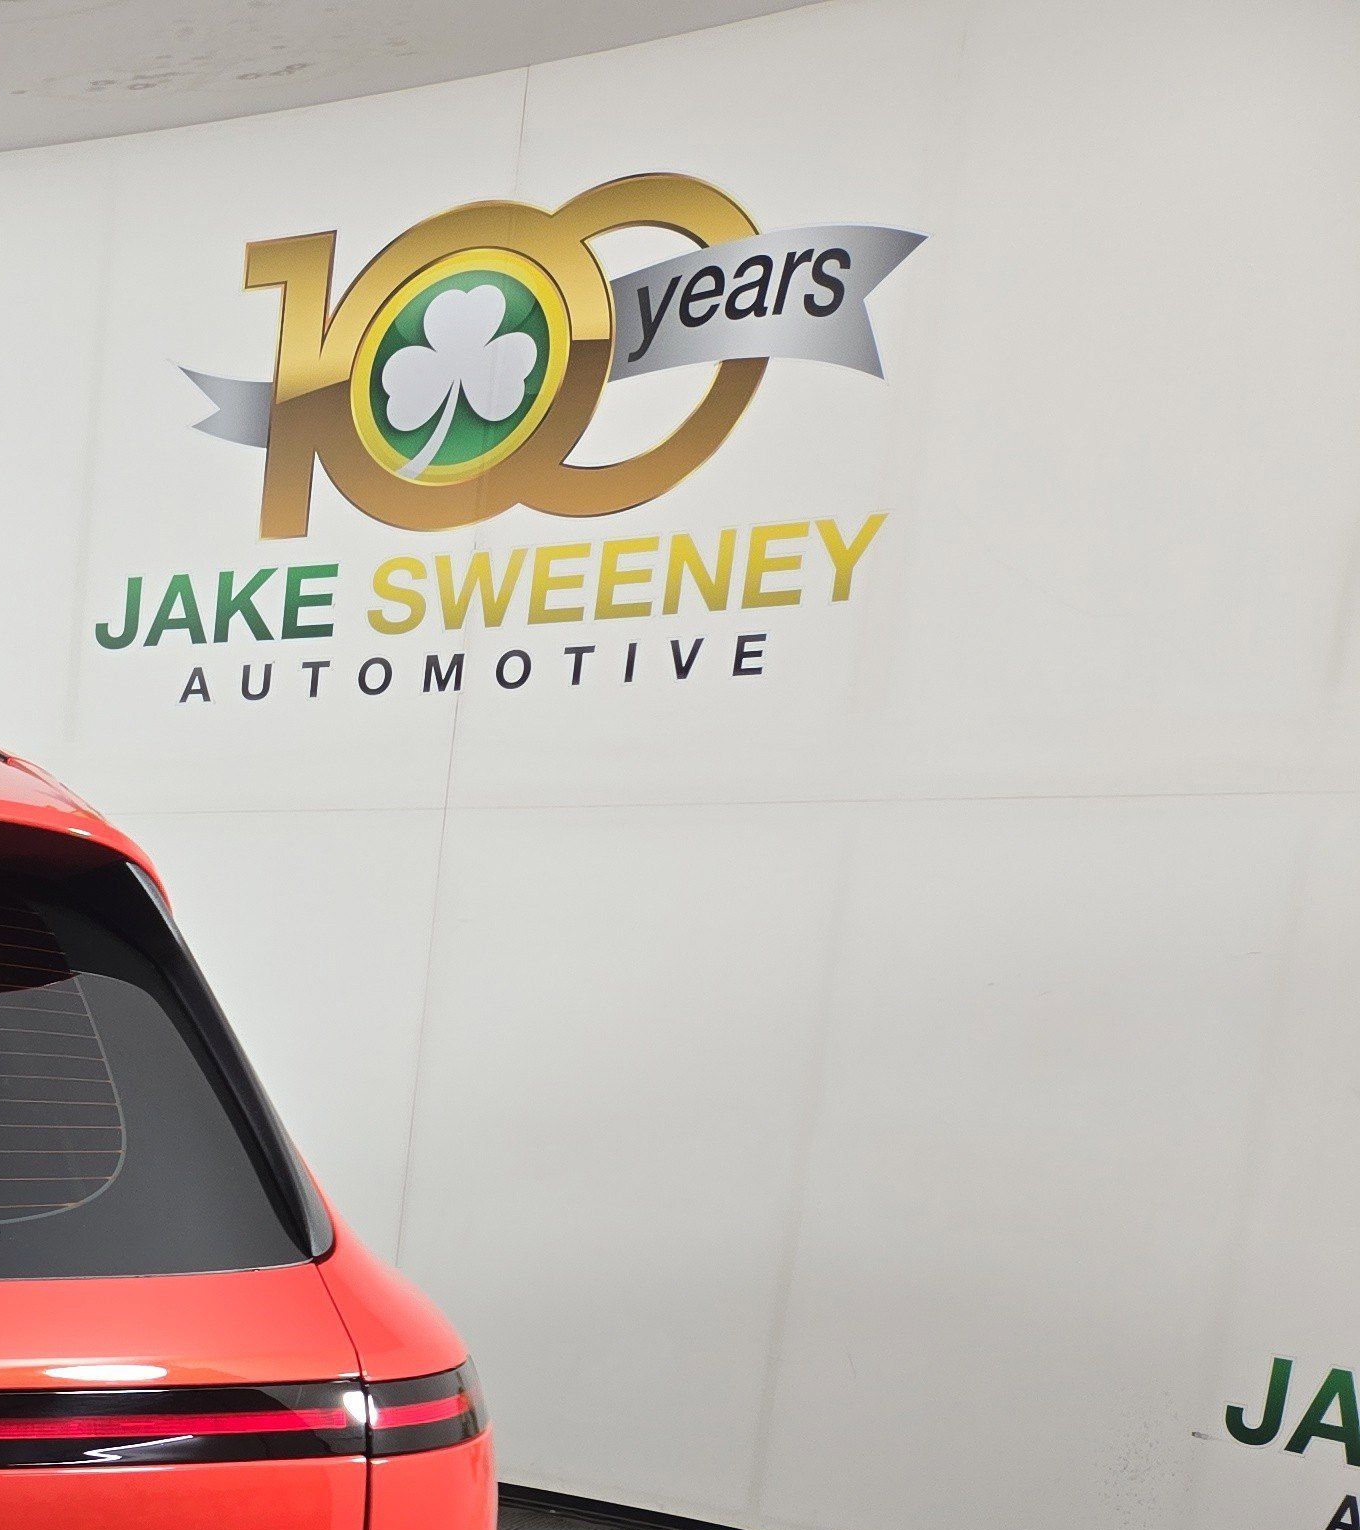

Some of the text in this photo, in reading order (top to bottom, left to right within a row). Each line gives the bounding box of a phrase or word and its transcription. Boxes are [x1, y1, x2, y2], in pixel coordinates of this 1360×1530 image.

[243, 172, 770, 541] 100
[627, 244, 852, 362] years
[94, 512, 889, 651] JAKE SWEENEY
[179, 633, 768, 705] AUTOMOTIVE
